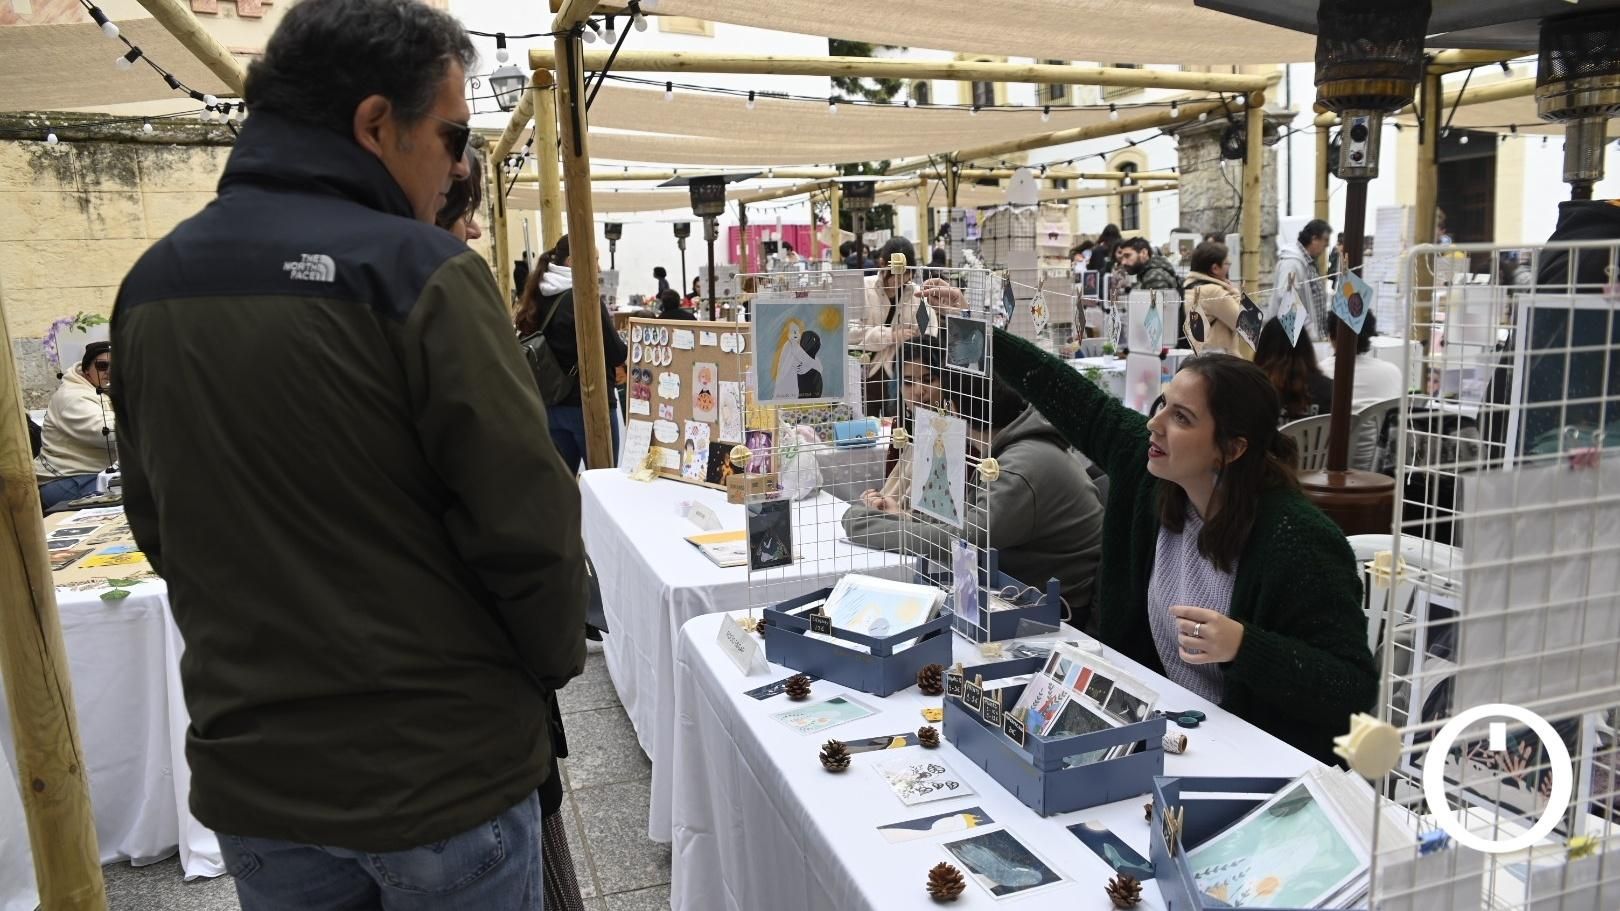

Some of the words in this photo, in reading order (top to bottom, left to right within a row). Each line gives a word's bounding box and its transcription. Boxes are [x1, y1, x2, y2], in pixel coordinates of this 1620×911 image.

[301, 254, 321, 263] THE
[283, 261, 319, 271] NORTH
[290, 270, 315, 280] FACE
